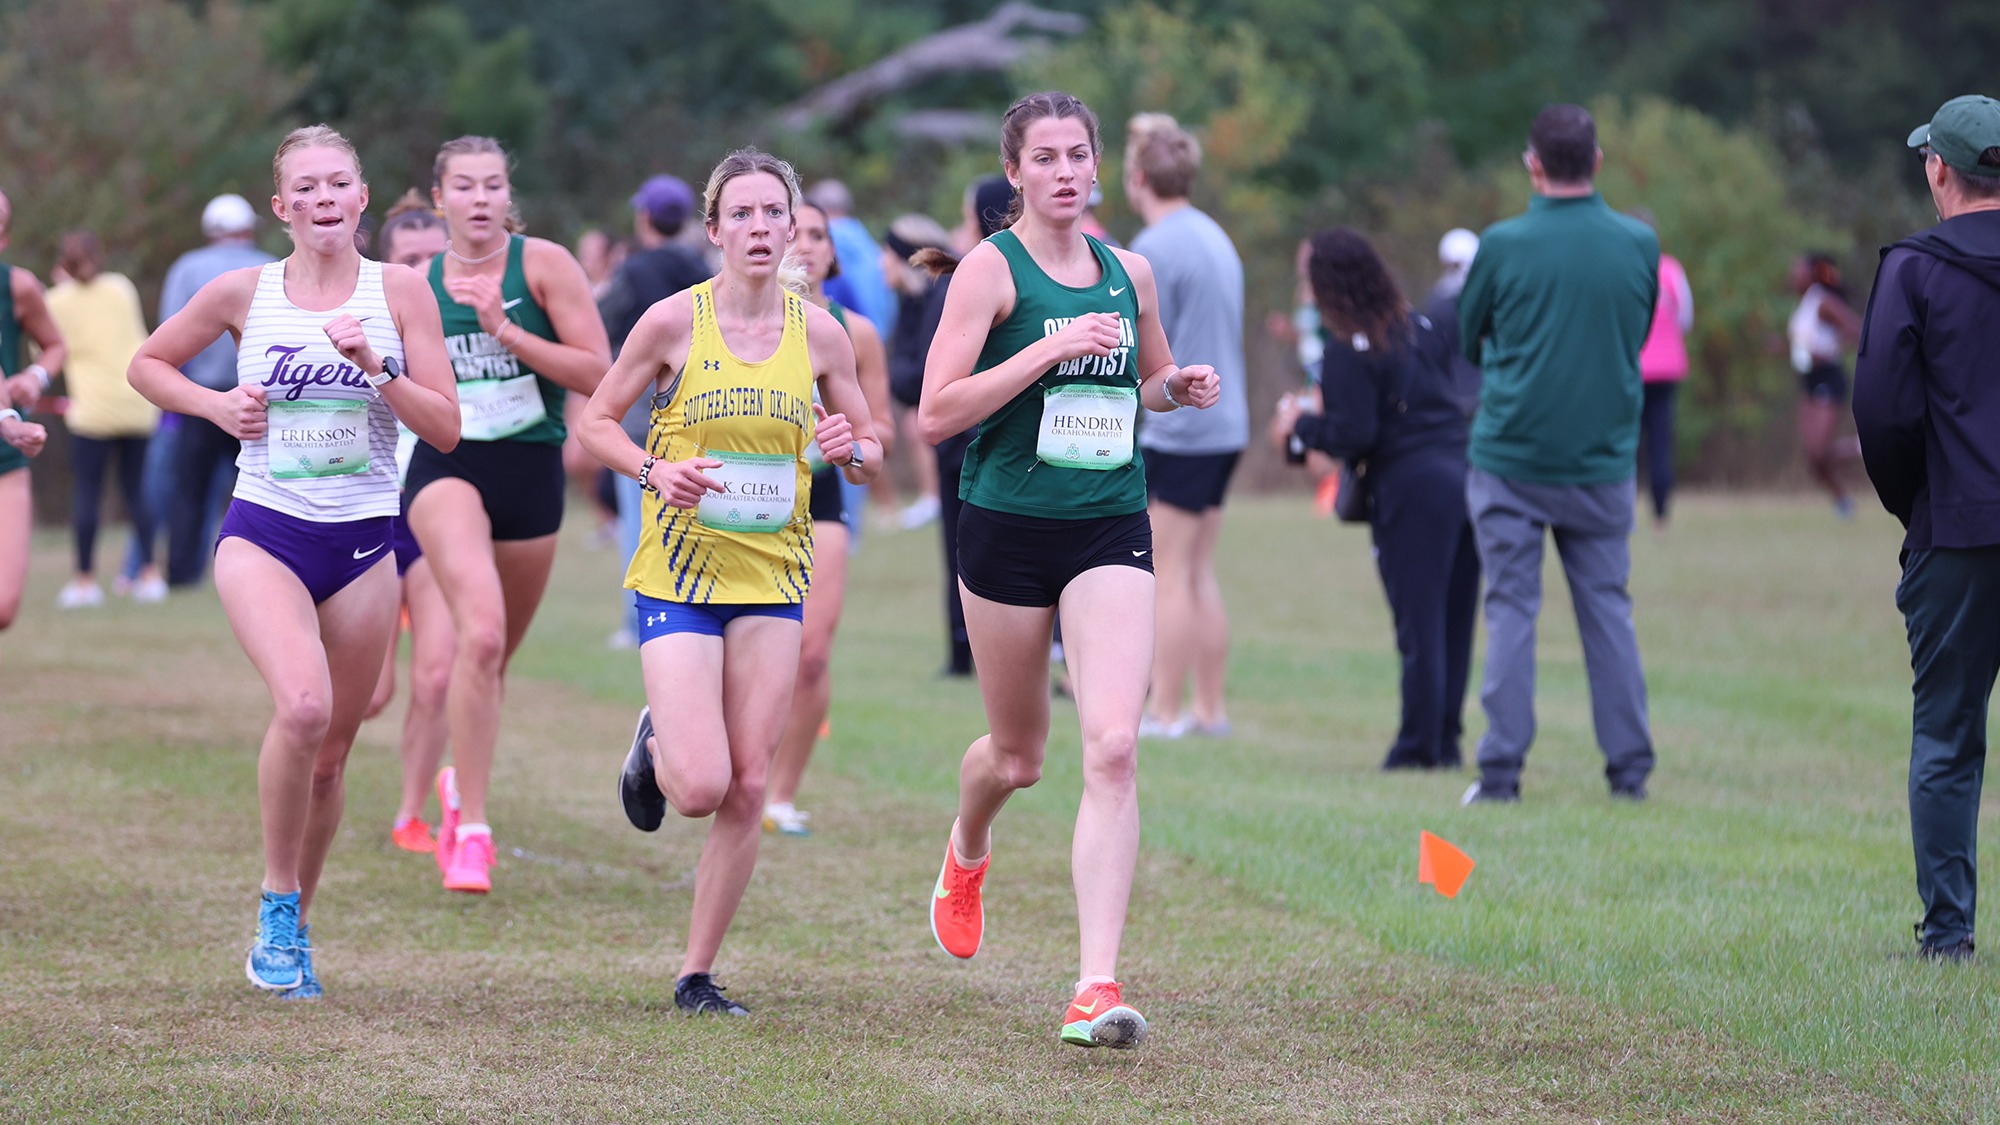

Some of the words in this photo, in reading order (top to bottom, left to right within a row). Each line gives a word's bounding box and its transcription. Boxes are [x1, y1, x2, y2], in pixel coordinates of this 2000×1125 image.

[683, 387, 763, 428] SOUTHEASTERN
[1054, 415, 1123, 431] HENDRIX
[281, 427, 357, 442] ERIKSSON
[1051, 428, 1096, 437] OKLAHOMA
[283, 441, 323, 449] OUACHITA
[325, 439, 355, 448] BAPTIST
[723, 481, 736, 494] K.
[741, 482, 779, 496] CLEM
[706, 492, 757, 502] SOUTHEASTERN
[757, 495, 792, 503] OKLAHOMA
